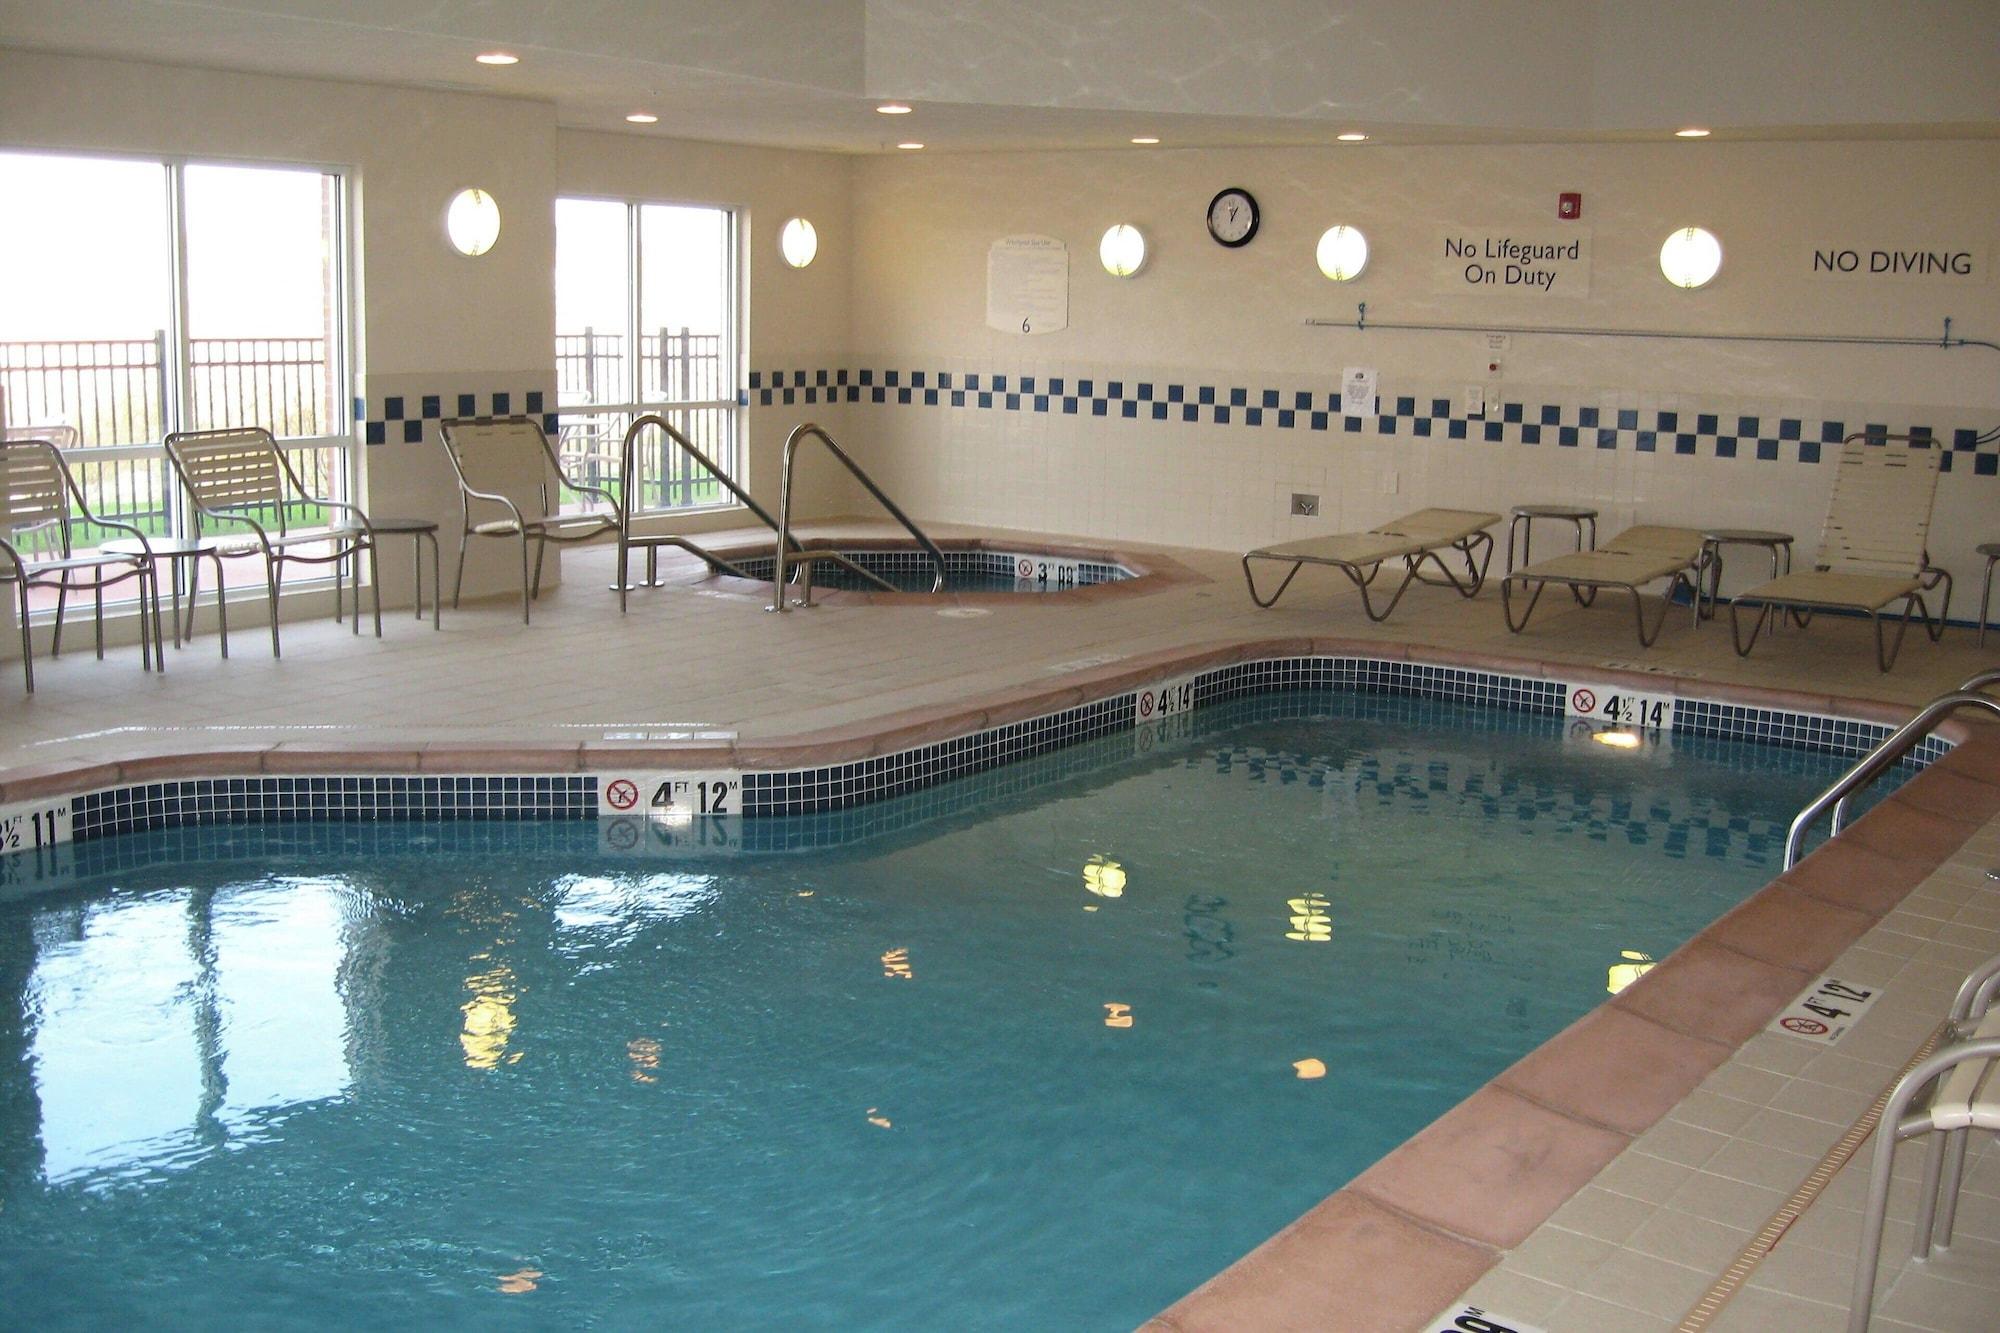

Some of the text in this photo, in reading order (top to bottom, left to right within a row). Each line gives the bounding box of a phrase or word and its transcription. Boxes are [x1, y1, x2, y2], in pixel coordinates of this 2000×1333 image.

[1445, 238, 1579, 265] No Lifeguard
[1814, 250, 1971, 275] NO DIVING
[1465, 264, 1556, 292] On Duty
[1022, 317, 1031, 334] 6
